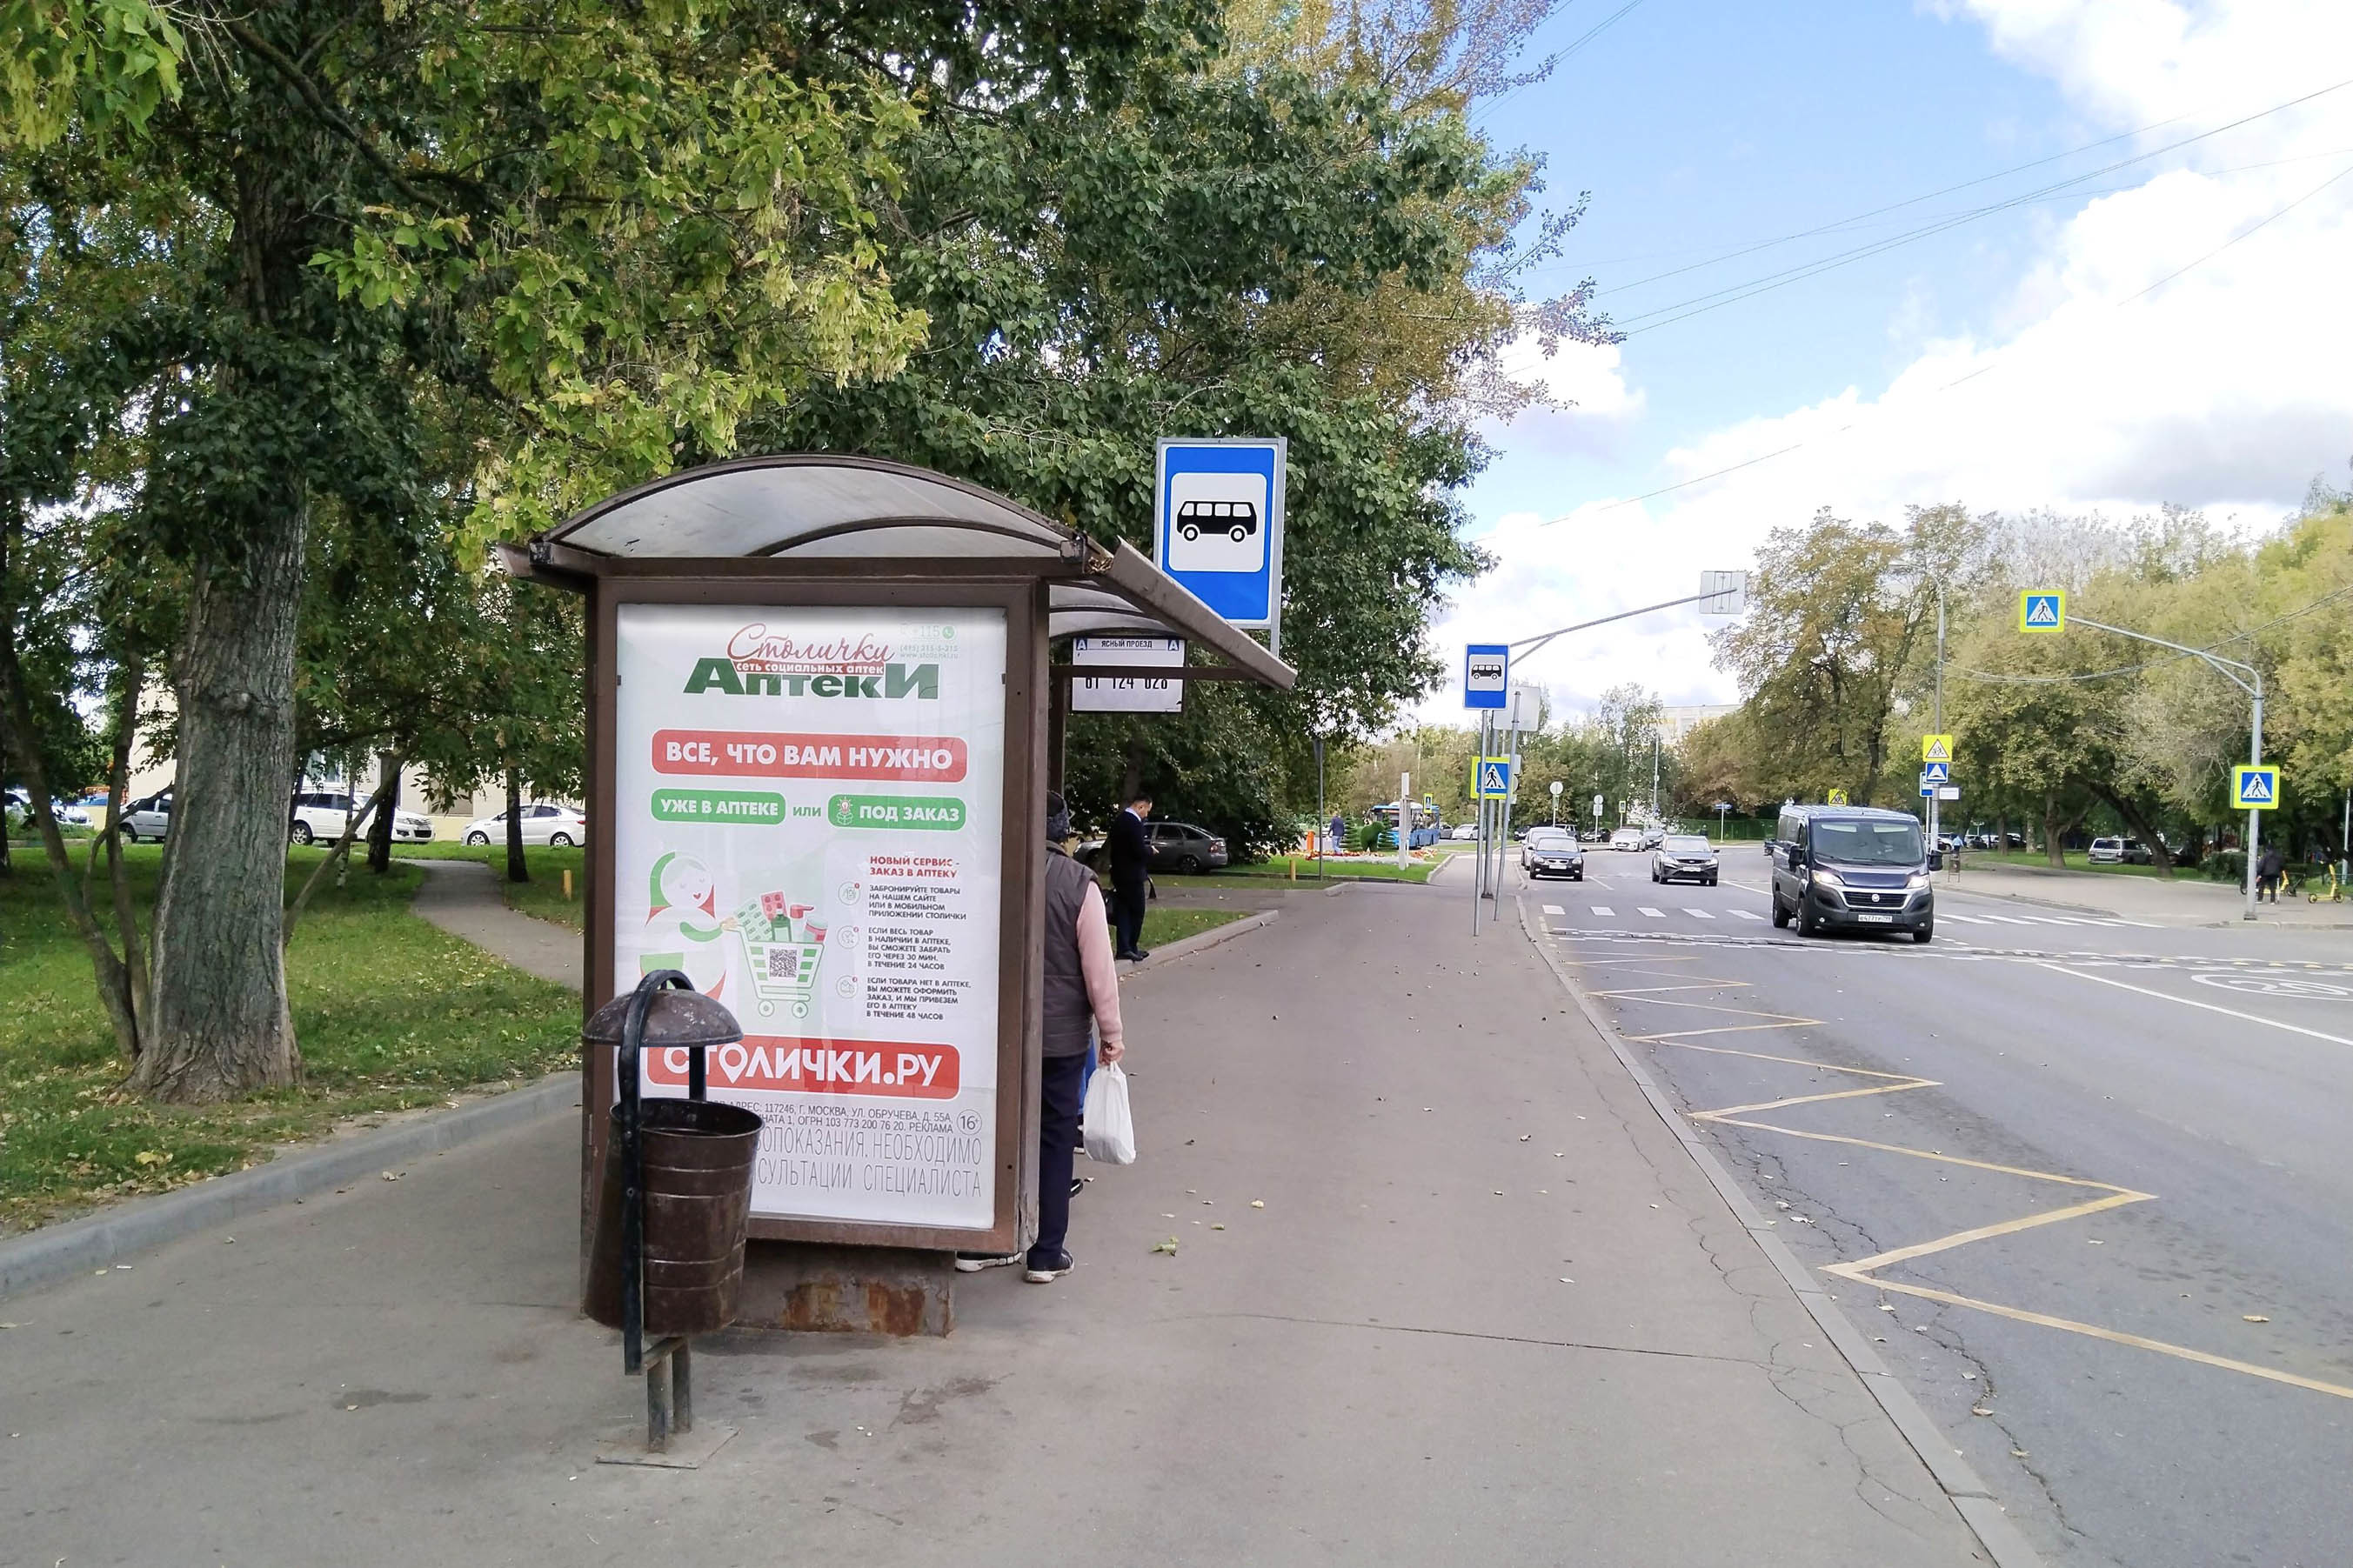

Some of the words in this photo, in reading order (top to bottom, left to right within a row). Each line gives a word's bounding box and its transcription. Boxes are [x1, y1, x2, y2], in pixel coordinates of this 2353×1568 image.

[727, 623, 895, 661] Столички
[1101, 639, 1125, 647] ЯСНЫЙ
[1126, 640, 1153, 649] ПРОЕЗД
[736, 662, 762, 671] сеть
[765, 663, 843, 674] социальных
[846, 665, 884, 675] аптек
[666, 742, 719, 766] ВСЕ,
[726, 744, 777, 765] ЧТО
[784, 745, 841, 766] ВАМ
[849, 747, 953, 770] НУЖНО
[660, 798, 697, 813] УЖЕ
[701, 801, 712, 814] В
[716, 801, 779, 816] АПТЕКЕ
[792, 806, 822, 817] ИЛИ
[859, 805, 899, 822] ПОД
[903, 807, 959, 822] ЗАКАЗ
[870, 856, 910, 866] НОВЫЙ
[913, 857, 953, 867] СЕРВИС
[870, 867, 905, 877] ЗАКАЗ
[917, 869, 957, 878] АПТЕКУ
[869, 884, 928, 894] ЗАБРОНИРУЙТЕ
[926, 912, 967, 920] СТОЛИЧКИ
[913, 987, 957, 996] ОФОРМИТЬ
[765, 1103, 797, 1115] 117246,
[799, 1105, 806, 1114] Г.
[808, 1106, 849, 1117] МОСКВА,
[852, 1108, 865, 1118] УЛ.
[868, 1109, 920, 1121] ОБРУЧЕВА,
[923, 1112, 931, 1123] Д.
[934, 1113, 953, 1123] 55А,
[759, 1114, 785, 1124] НАТА
[787, 1116, 795, 1126] 1,
[798, 1117, 823, 1126] ОГРН
[826, 1118, 841, 1127] 103
[844, 1118, 859, 1128] 773
[862, 1119, 878, 1129] 200
[880, 1121, 891, 1130] 76
[894, 1122, 906, 1131] 20.
[909, 1122, 954, 1134] РЕКЛАМА
[959, 1115, 979, 1130] 16+
[873, 1132, 982, 1167] НЕОБХОДИМО
[754, 1158, 852, 1191] СУЛЬТАЦИИ
[864, 1164, 982, 1197] СПЕЦИАЛИСТА
